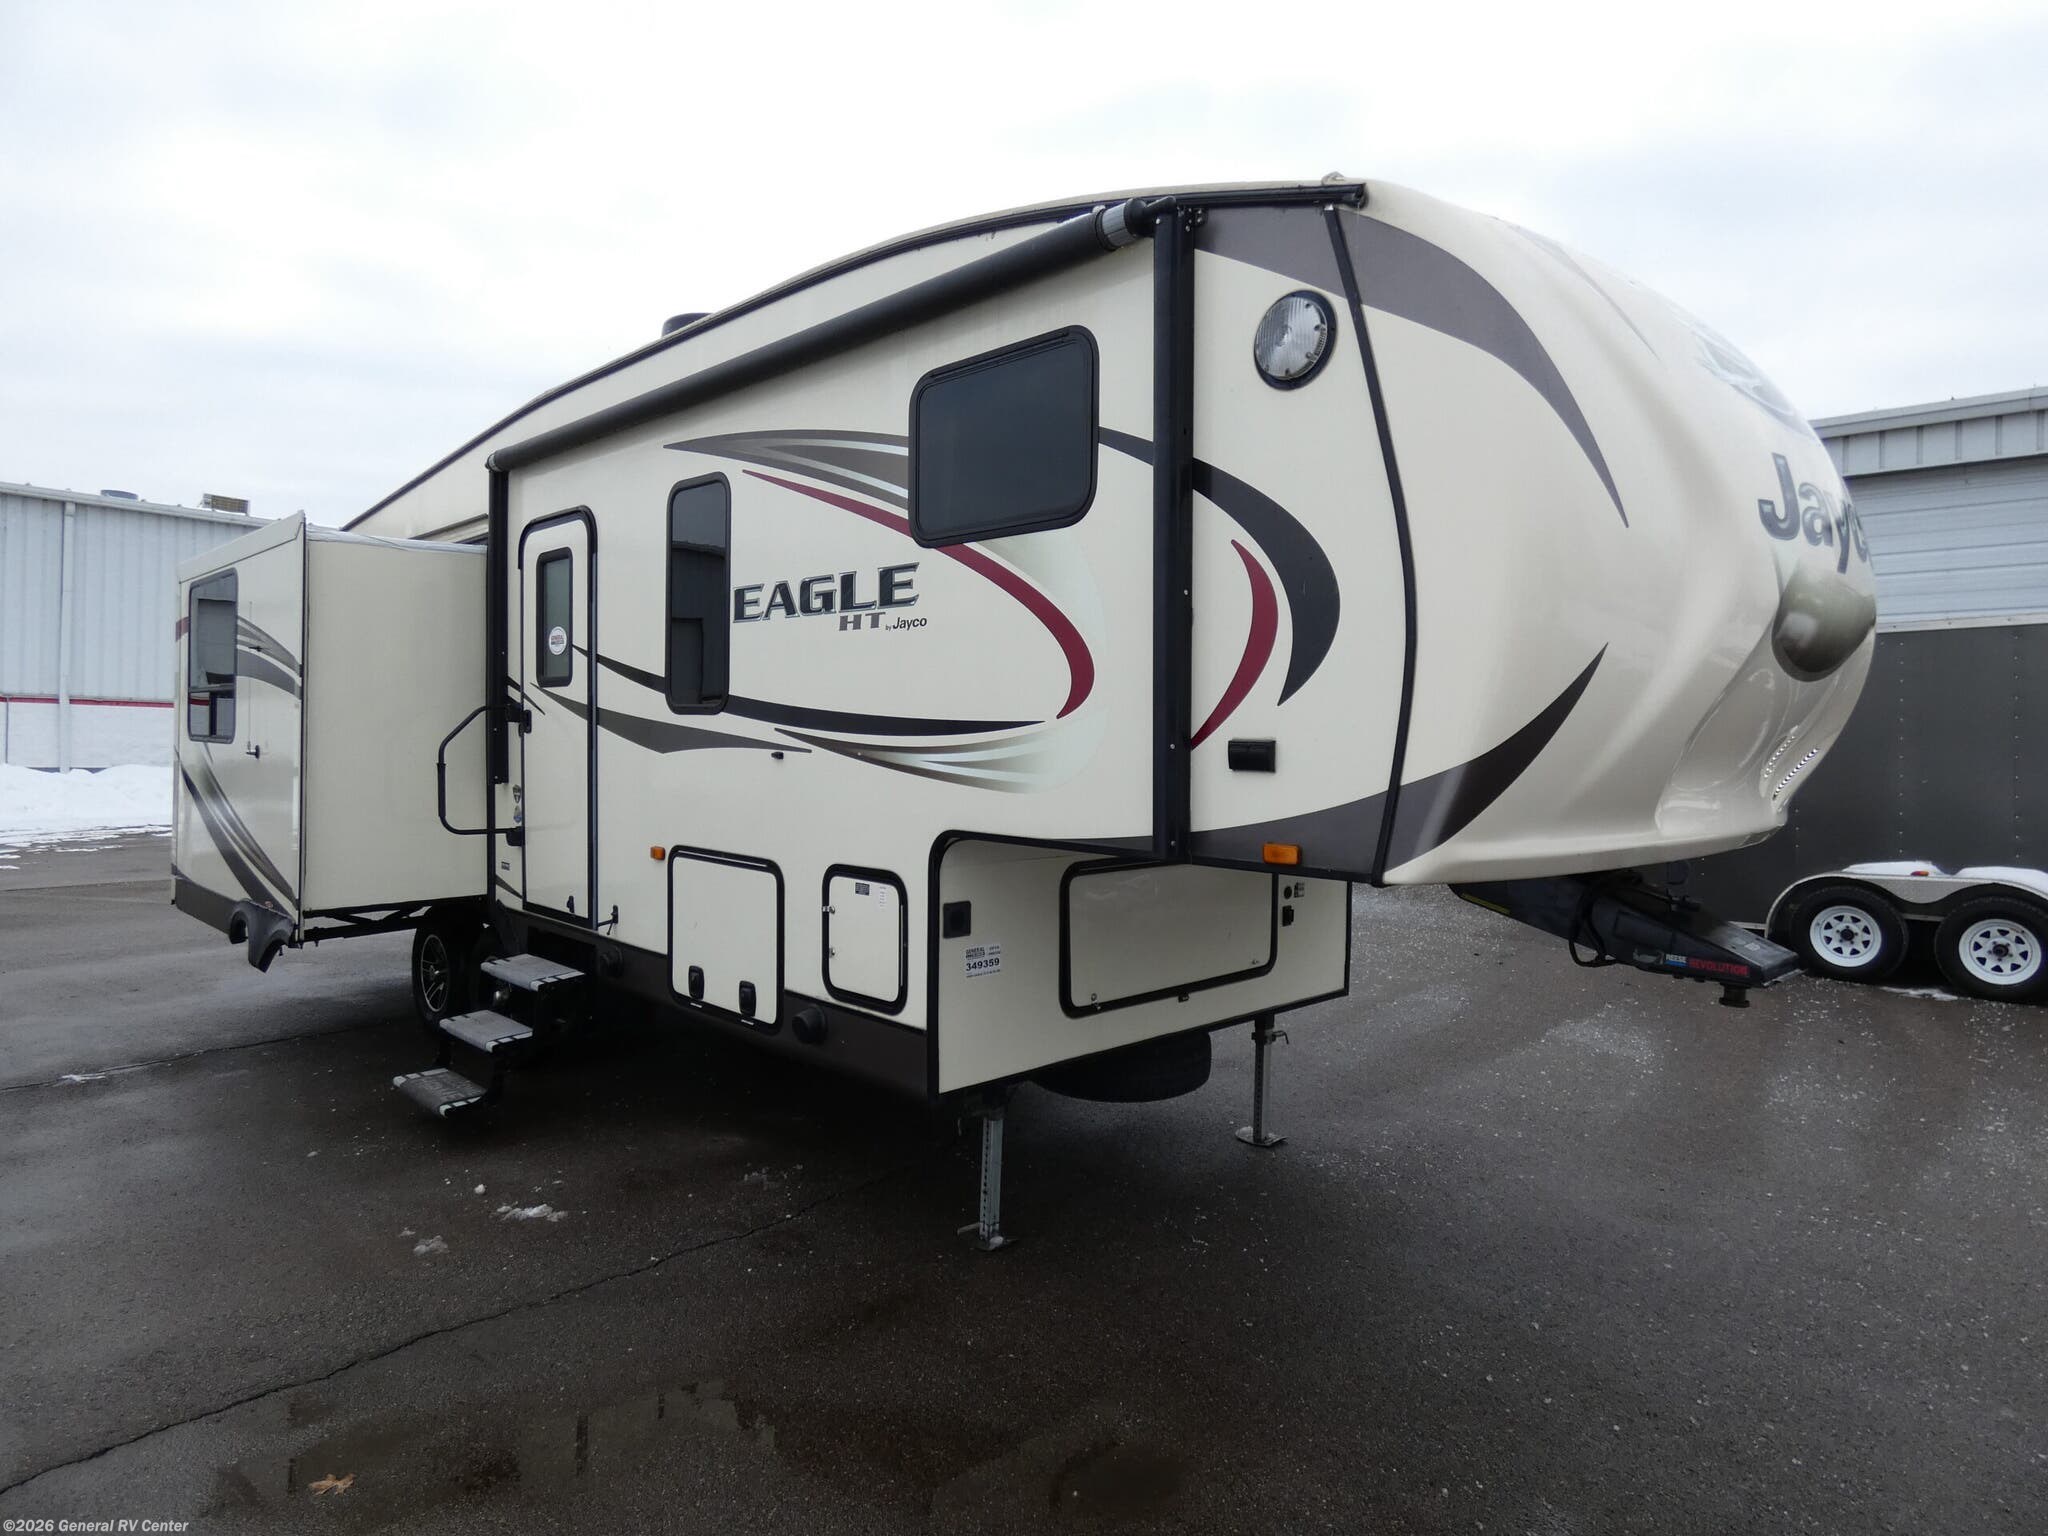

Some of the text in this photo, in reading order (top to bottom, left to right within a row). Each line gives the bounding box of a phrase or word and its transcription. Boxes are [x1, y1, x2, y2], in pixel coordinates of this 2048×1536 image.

[1757, 452, 1870, 575] Jayc
[733, 562, 920, 624] EAGLE
[839, 612, 886, 631] HT
[892, 616, 928, 632] Jayco
[966, 957, 1000, 971] 349359
[1688, 958, 1748, 975] REVOLUTION
